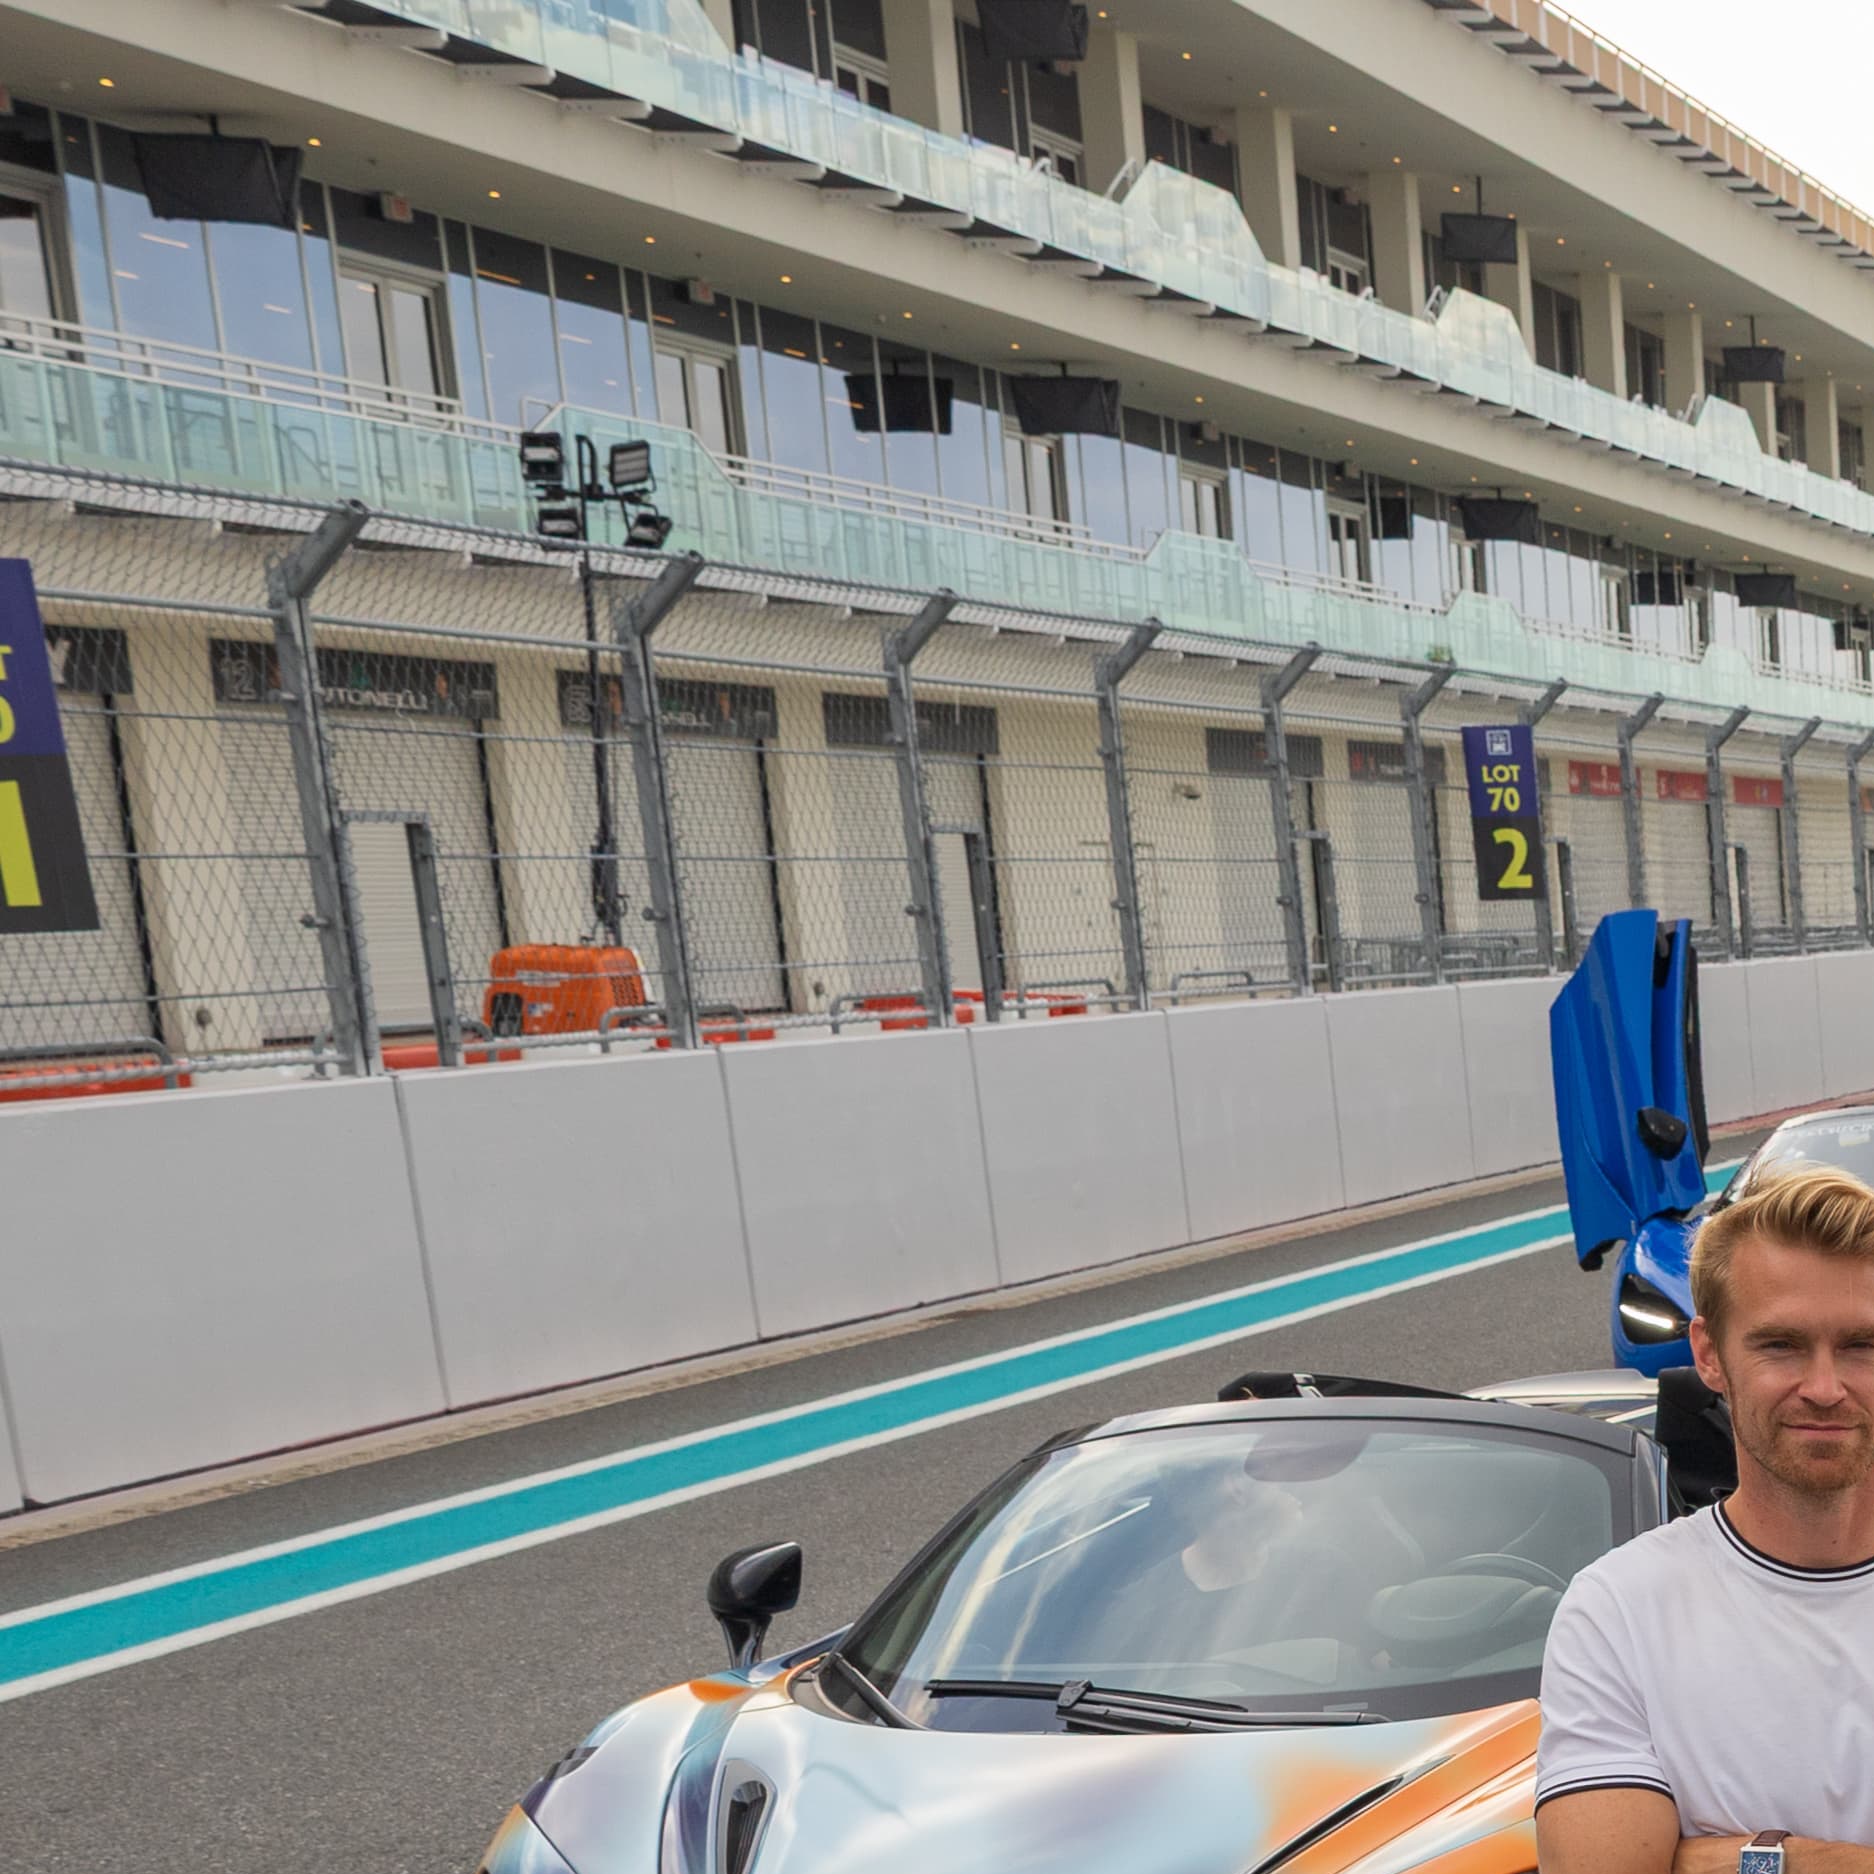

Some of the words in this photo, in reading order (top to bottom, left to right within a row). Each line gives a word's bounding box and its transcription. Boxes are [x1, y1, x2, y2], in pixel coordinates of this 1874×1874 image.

[1481, 764, 1521, 783] LOT
[1486, 786, 1522, 812] 70
[1492, 827, 1534, 889] 2
